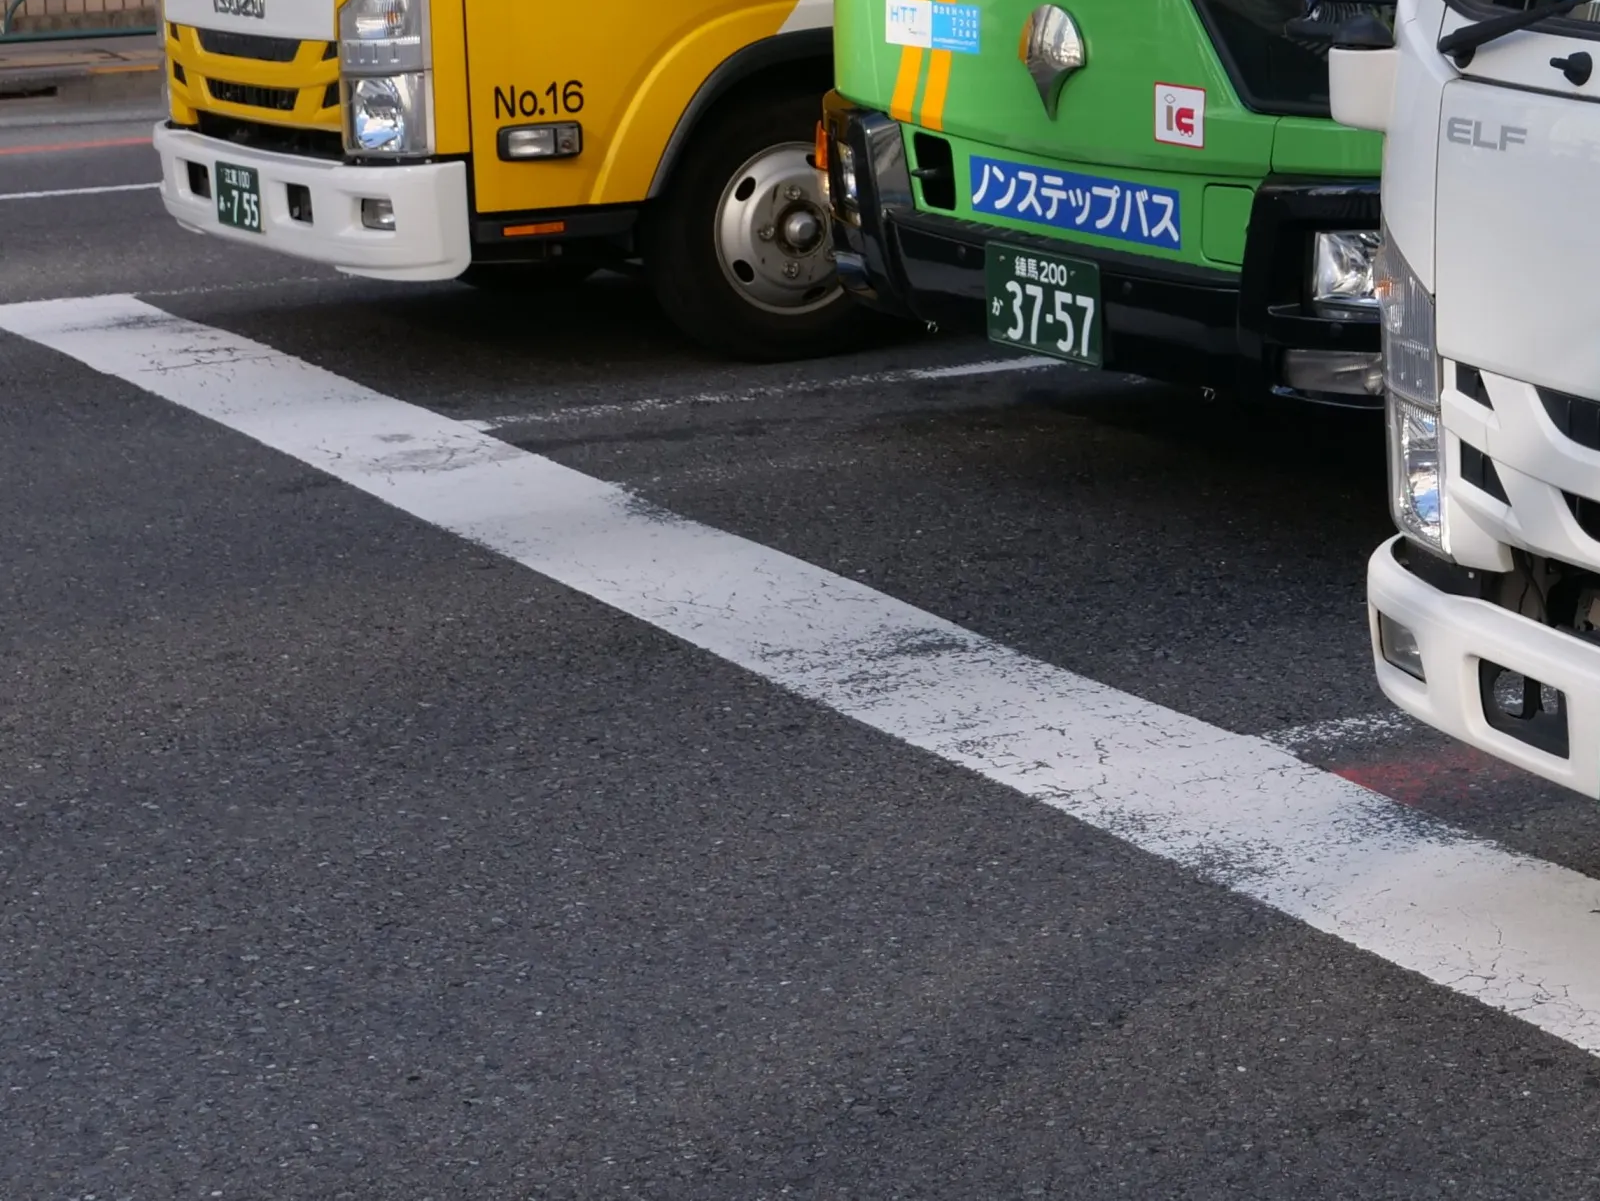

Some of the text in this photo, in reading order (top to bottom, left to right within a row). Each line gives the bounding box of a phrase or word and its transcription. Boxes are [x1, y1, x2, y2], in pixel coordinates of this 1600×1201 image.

[494, 79, 585, 119] No.16
[1446, 116, 1528, 151] ELF
[972, 163, 1180, 244] ノンステップバス
[991, 280, 1095, 357] か 37-57
